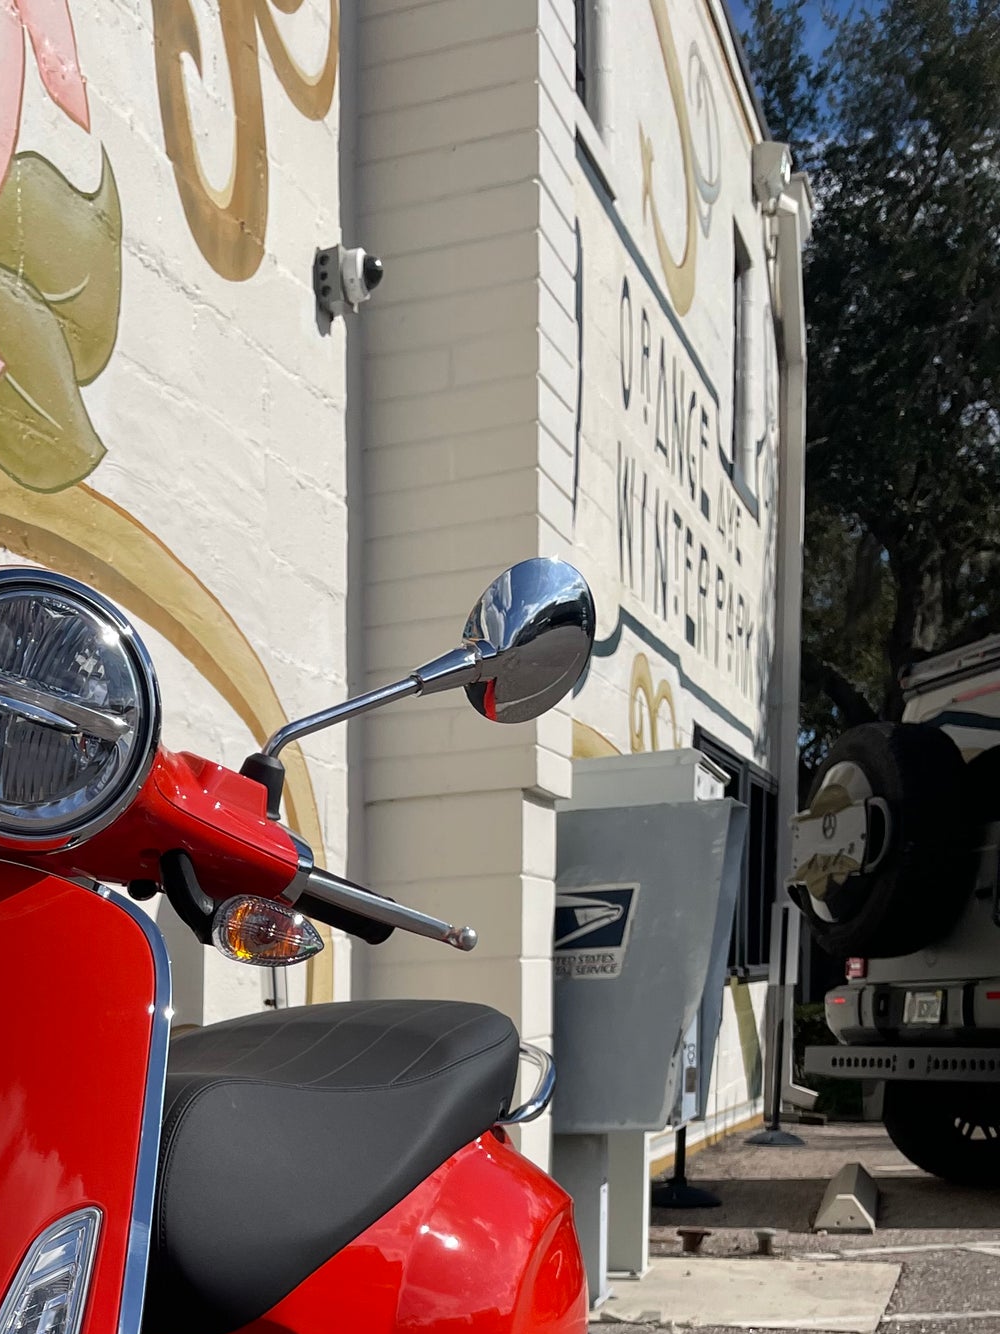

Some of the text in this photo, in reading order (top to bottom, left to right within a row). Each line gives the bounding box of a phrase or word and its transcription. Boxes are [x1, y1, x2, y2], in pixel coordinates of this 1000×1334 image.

[619, 274, 742, 567] ORANGE AVE
[616, 440, 757, 702] WINTER PARK
[553, 953, 615, 966] TED STATES
[575, 962, 618, 976] SERVICE
